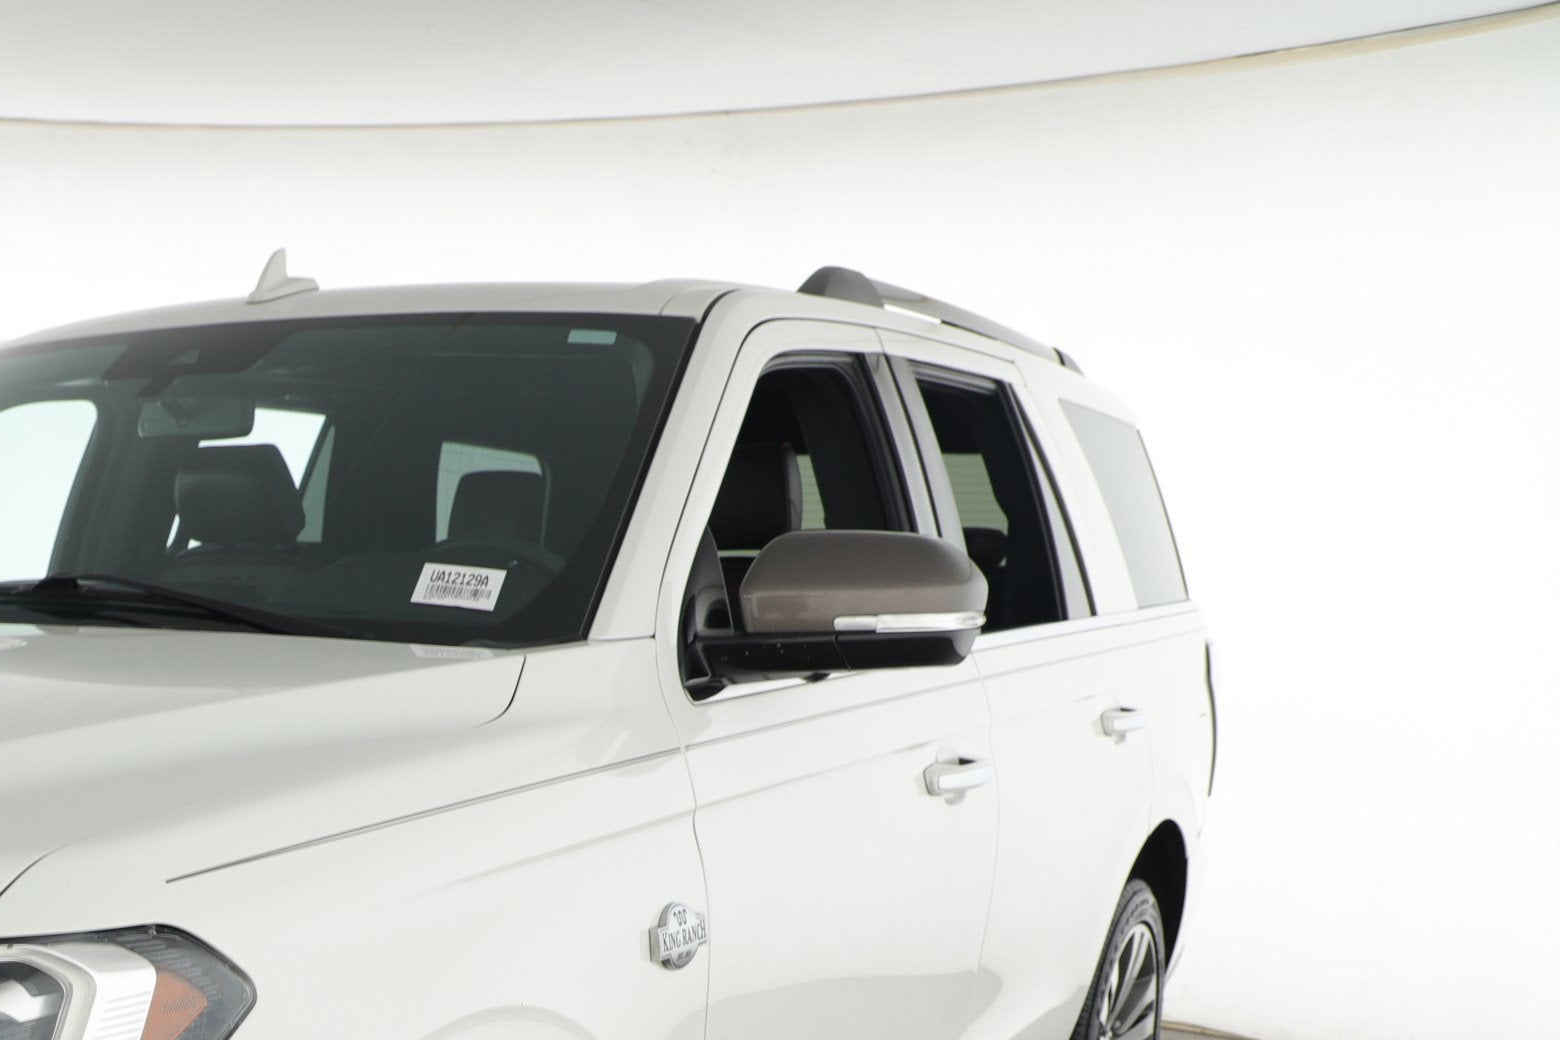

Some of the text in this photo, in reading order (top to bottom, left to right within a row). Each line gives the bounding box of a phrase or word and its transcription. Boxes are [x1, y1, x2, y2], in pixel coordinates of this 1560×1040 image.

[430, 569, 489, 588] UA12129A
[662, 919, 707, 953] KING RANCH
